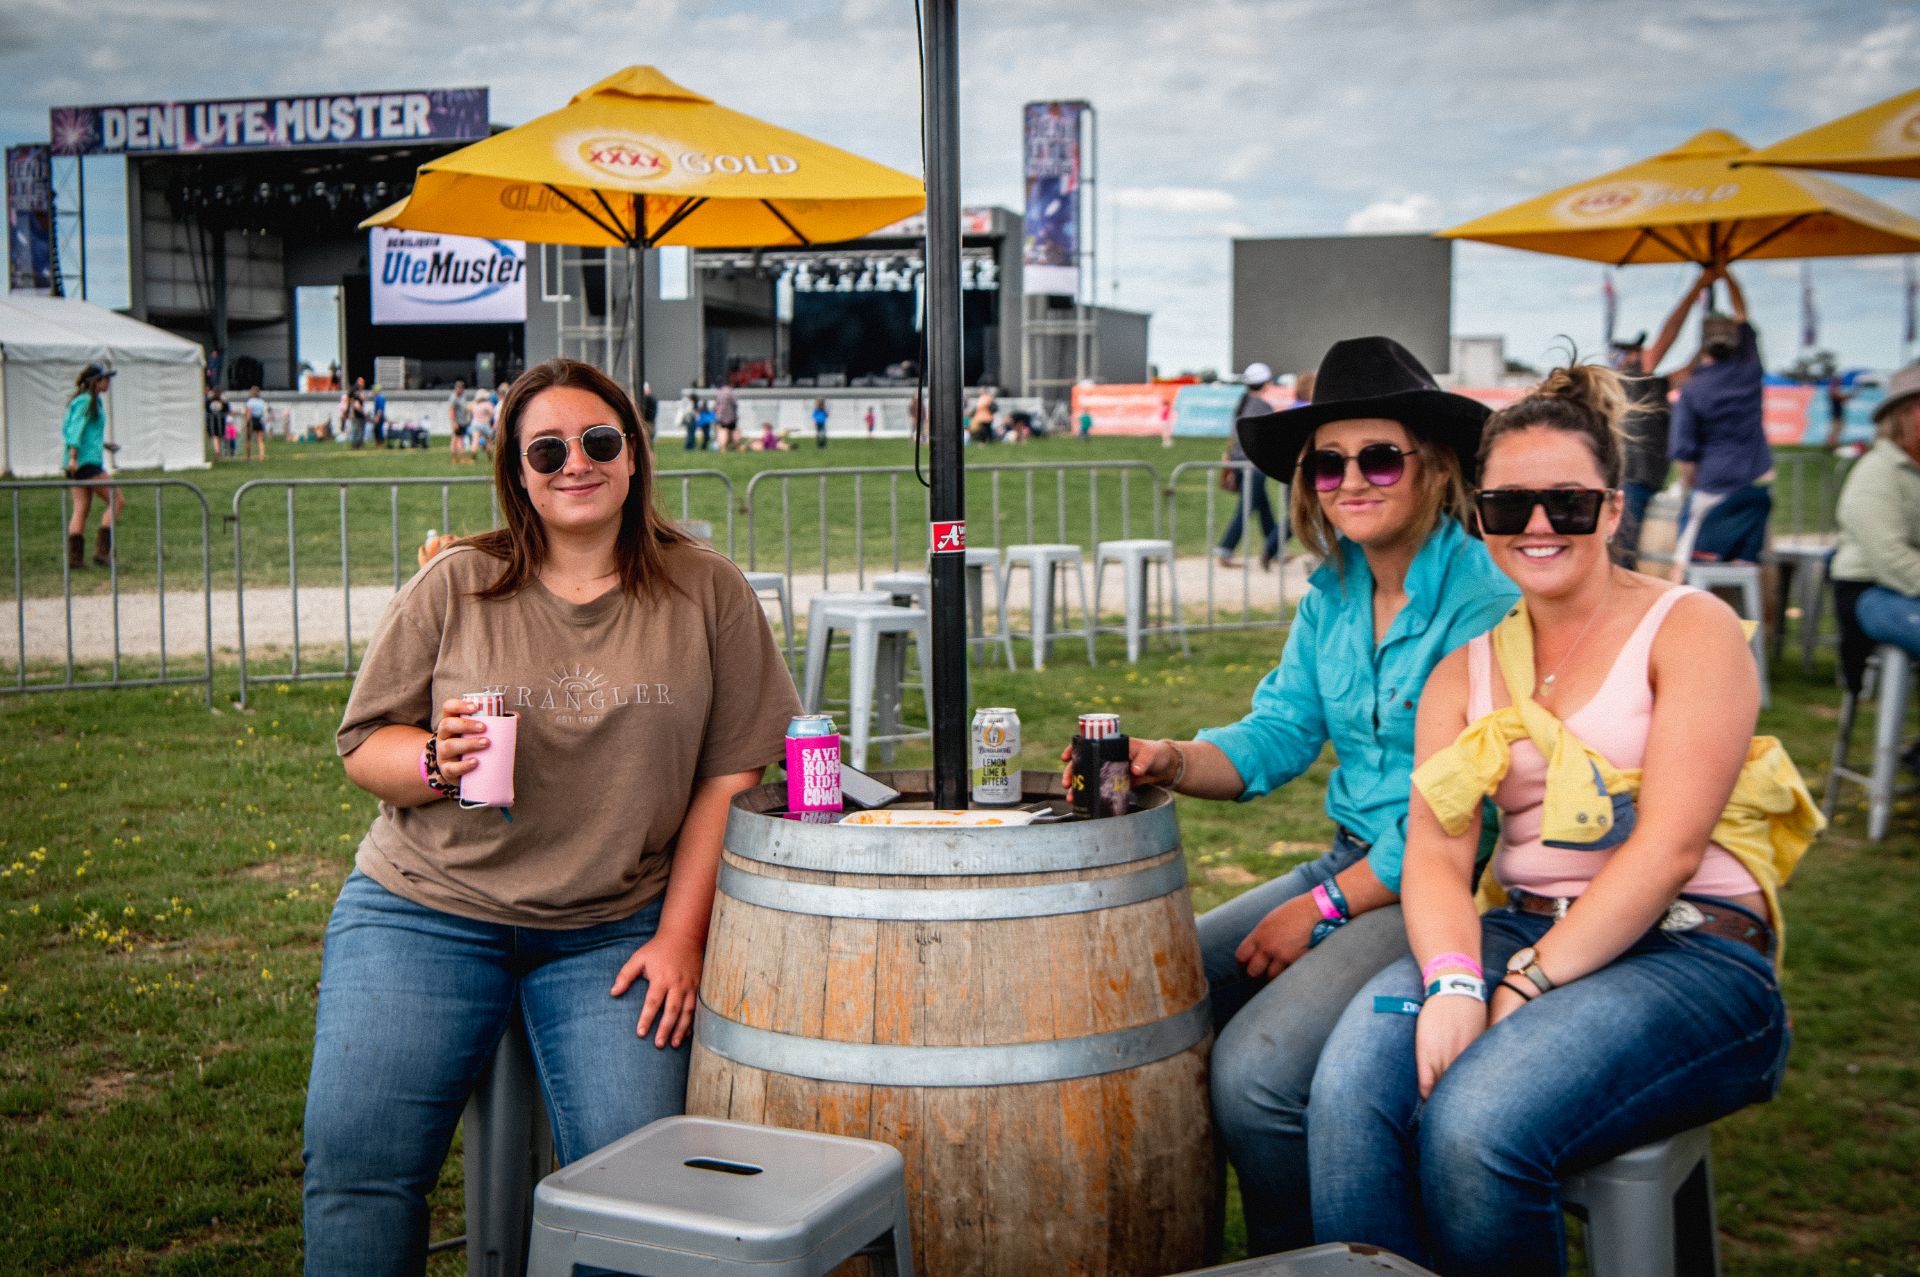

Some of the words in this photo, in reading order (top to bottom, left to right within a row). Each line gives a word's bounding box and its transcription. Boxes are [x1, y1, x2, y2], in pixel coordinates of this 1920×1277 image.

[101, 105, 186, 148] DENI
[194, 101, 268, 145] UTE
[275, 94, 431, 143] MUSTER
[589, 149, 667, 170] XXXX
[678, 151, 799, 175] GOLD
[382, 251, 526, 285] UteMuster
[801, 747, 838, 761] SAVE
[982, 758, 1007, 767] LEMON
[983, 768, 1000, 777] LIME
[1001, 768, 1007, 777] &
[804, 774, 838, 789] RIDE
[981, 777, 1009, 786] BITTERS
